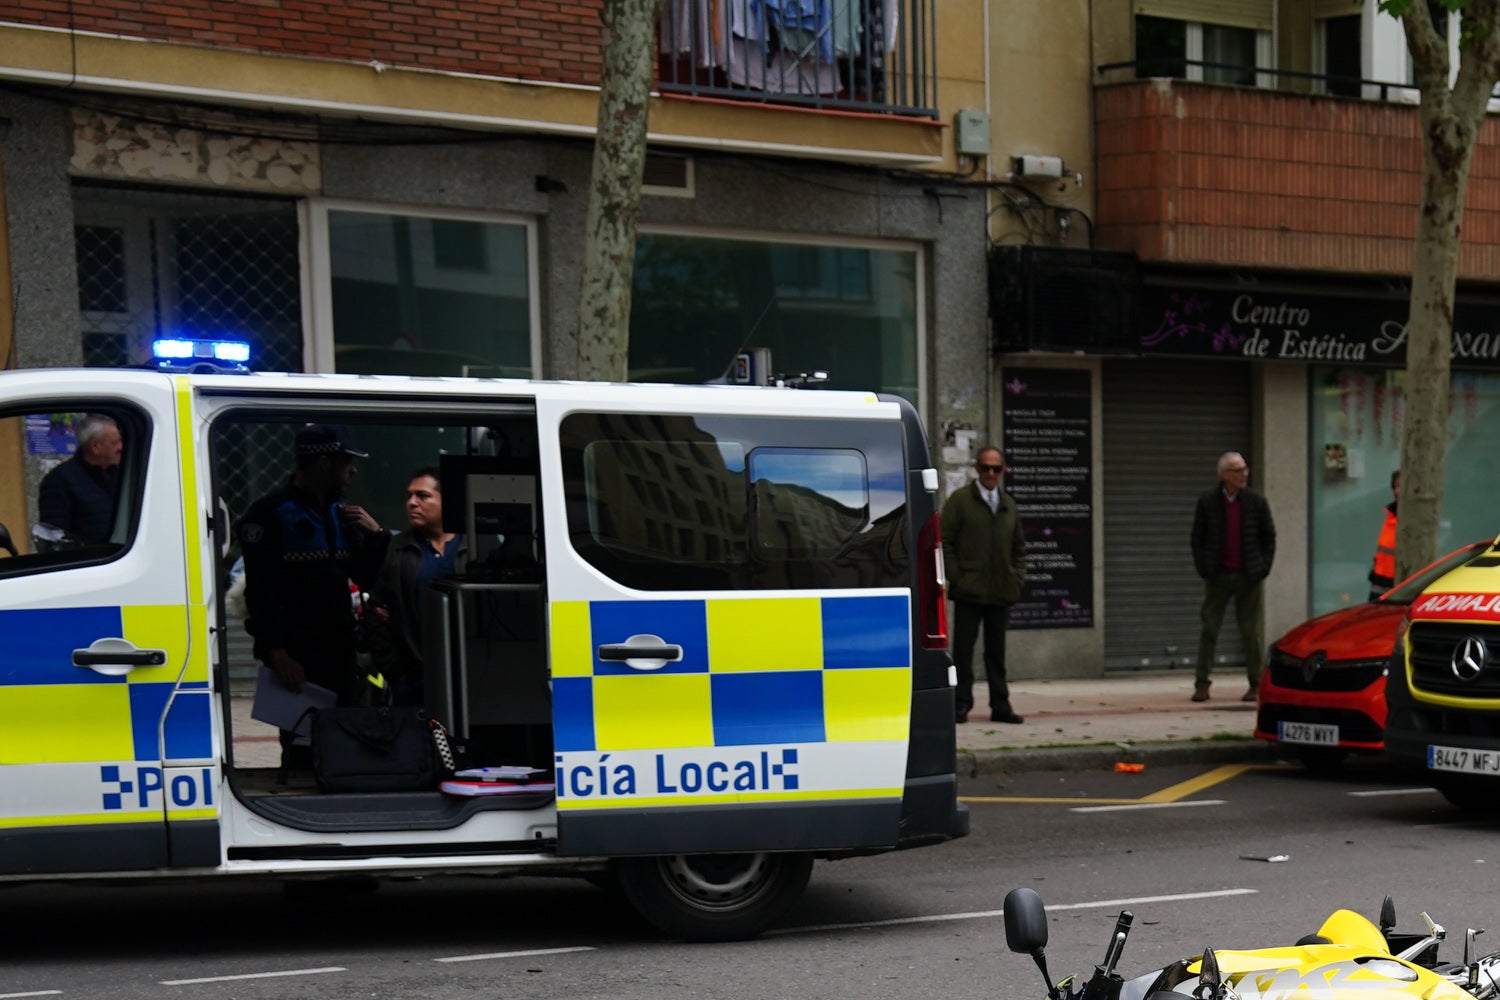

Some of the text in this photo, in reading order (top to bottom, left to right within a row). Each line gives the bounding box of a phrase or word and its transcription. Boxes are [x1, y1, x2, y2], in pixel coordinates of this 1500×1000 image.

[1231, 294, 1311, 326] Centro
[1242, 328, 1367, 361] de Estética
[1285, 724, 1311, 741] 4276
[555, 751, 769, 797] icía Local
[1435, 750, 1500, 771] 8447 MFJ
[137, 767, 213, 807] Pol
